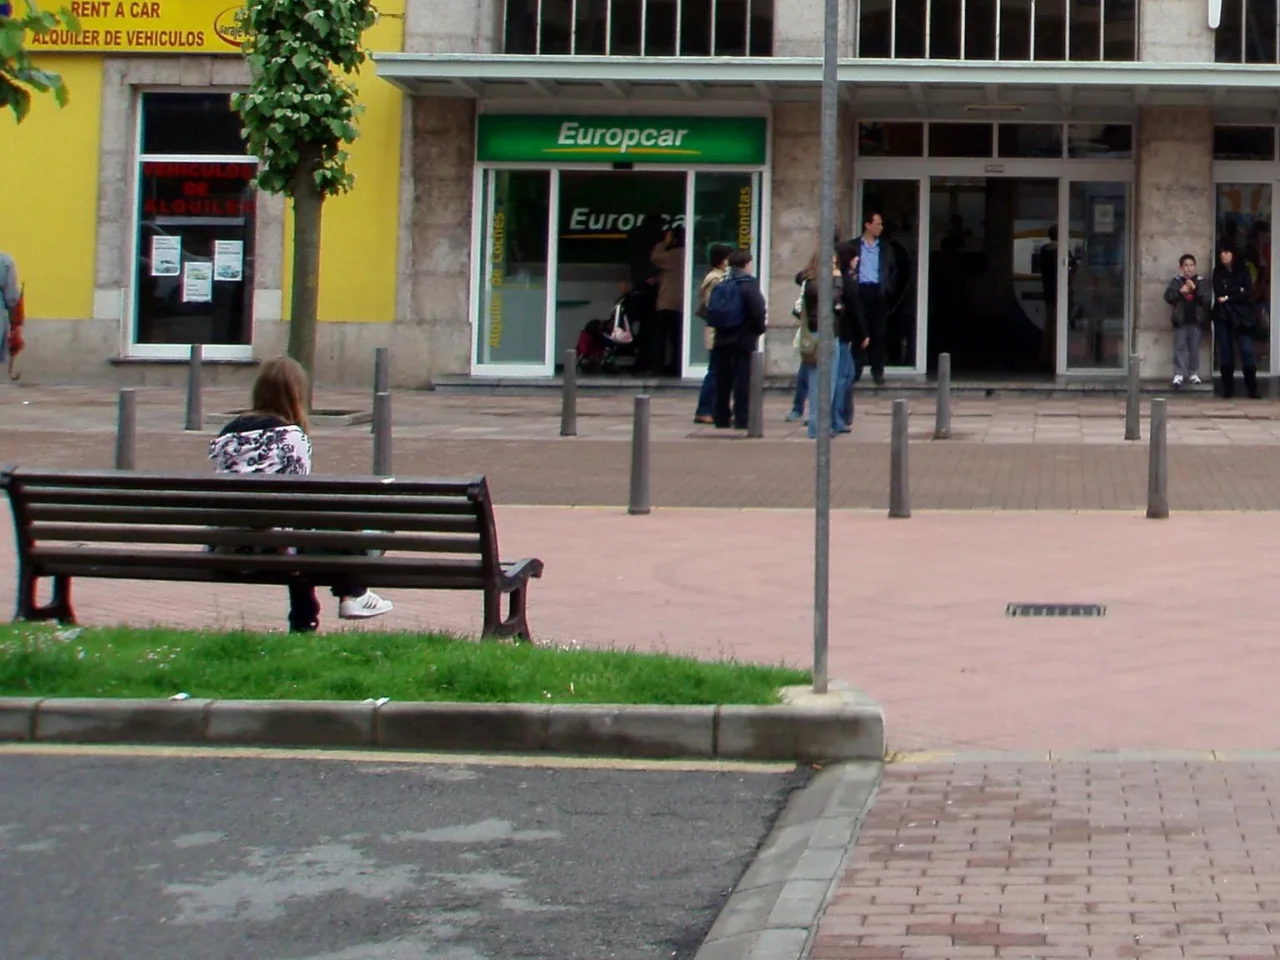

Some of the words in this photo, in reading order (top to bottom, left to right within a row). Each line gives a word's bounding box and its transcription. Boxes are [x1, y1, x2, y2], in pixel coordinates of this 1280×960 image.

[71, 1, 110, 18] RENT
[115, 2, 125, 18] A
[130, 2, 160, 18] CAR
[32, 30, 100, 46] ALQUILER
[104, 30, 121, 46] DE
[127, 31, 205, 47] VEHICULOS
[557, 122, 688, 153] Europcar
[143, 163, 252, 180] VEHICULOS
[183, 181, 208, 196] DE
[144, 199, 256, 215] ALQUILER
[491, 212, 504, 263] Coches
